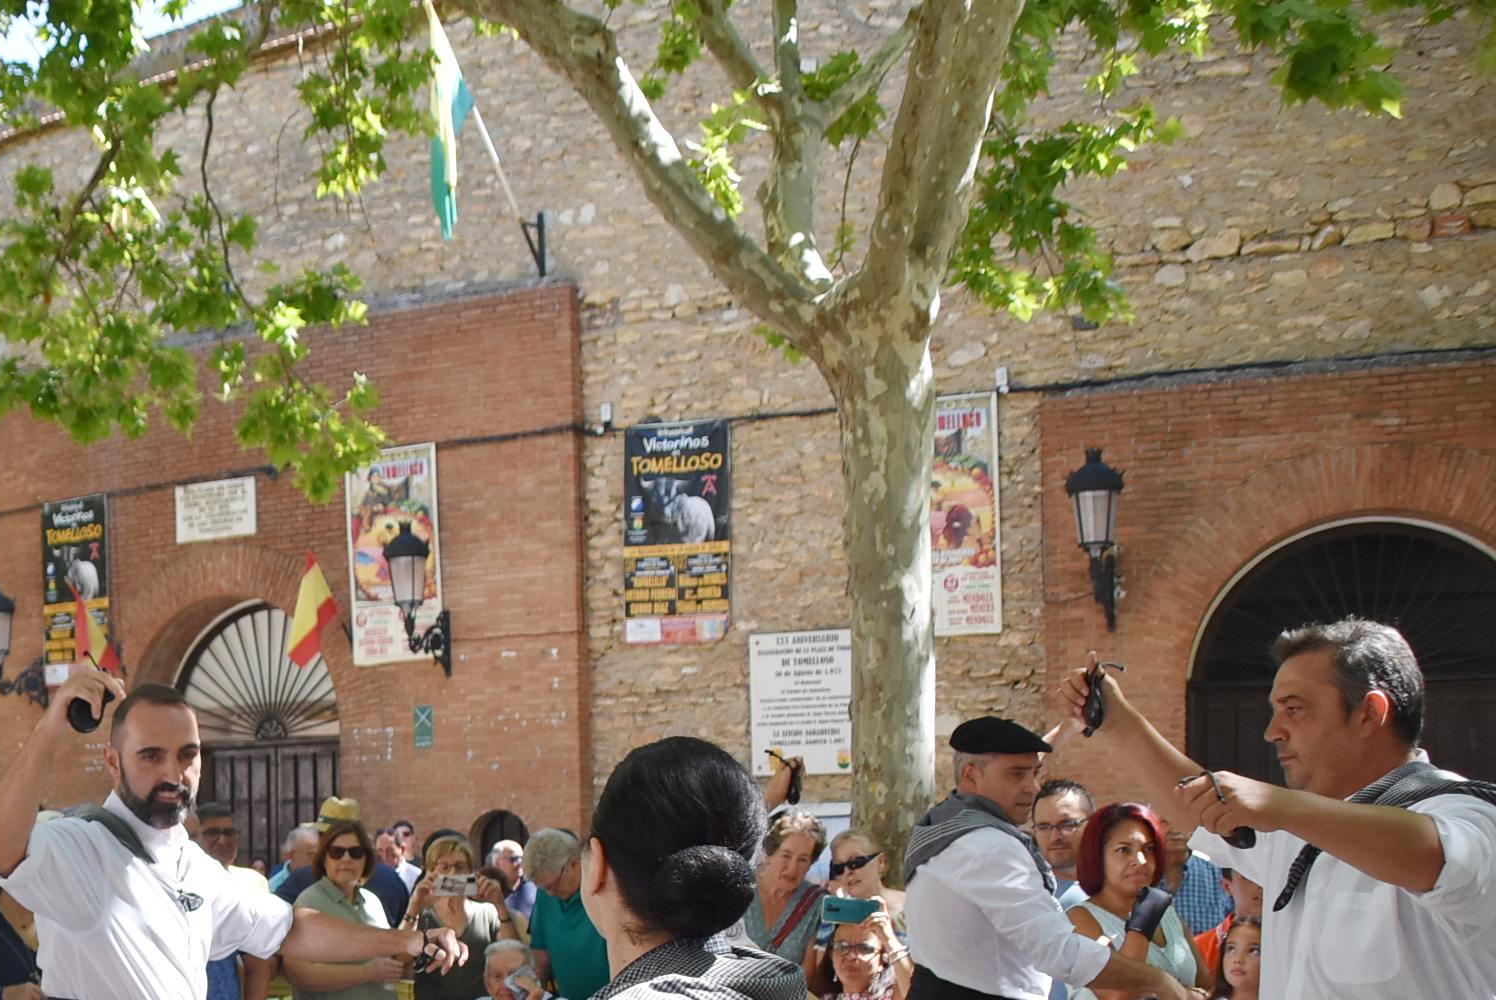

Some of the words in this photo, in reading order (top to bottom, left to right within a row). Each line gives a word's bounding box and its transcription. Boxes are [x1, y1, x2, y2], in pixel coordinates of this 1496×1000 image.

[642, 435, 710, 453] Victorinos
[630, 451, 724, 475] TOMELLOSO
[46, 523, 103, 545] TOMELLOSO
[791, 633, 840, 644] ANIVERSARIO
[781, 658, 790, 667] DE
[793, 656, 835, 666] TOMELLOSO
